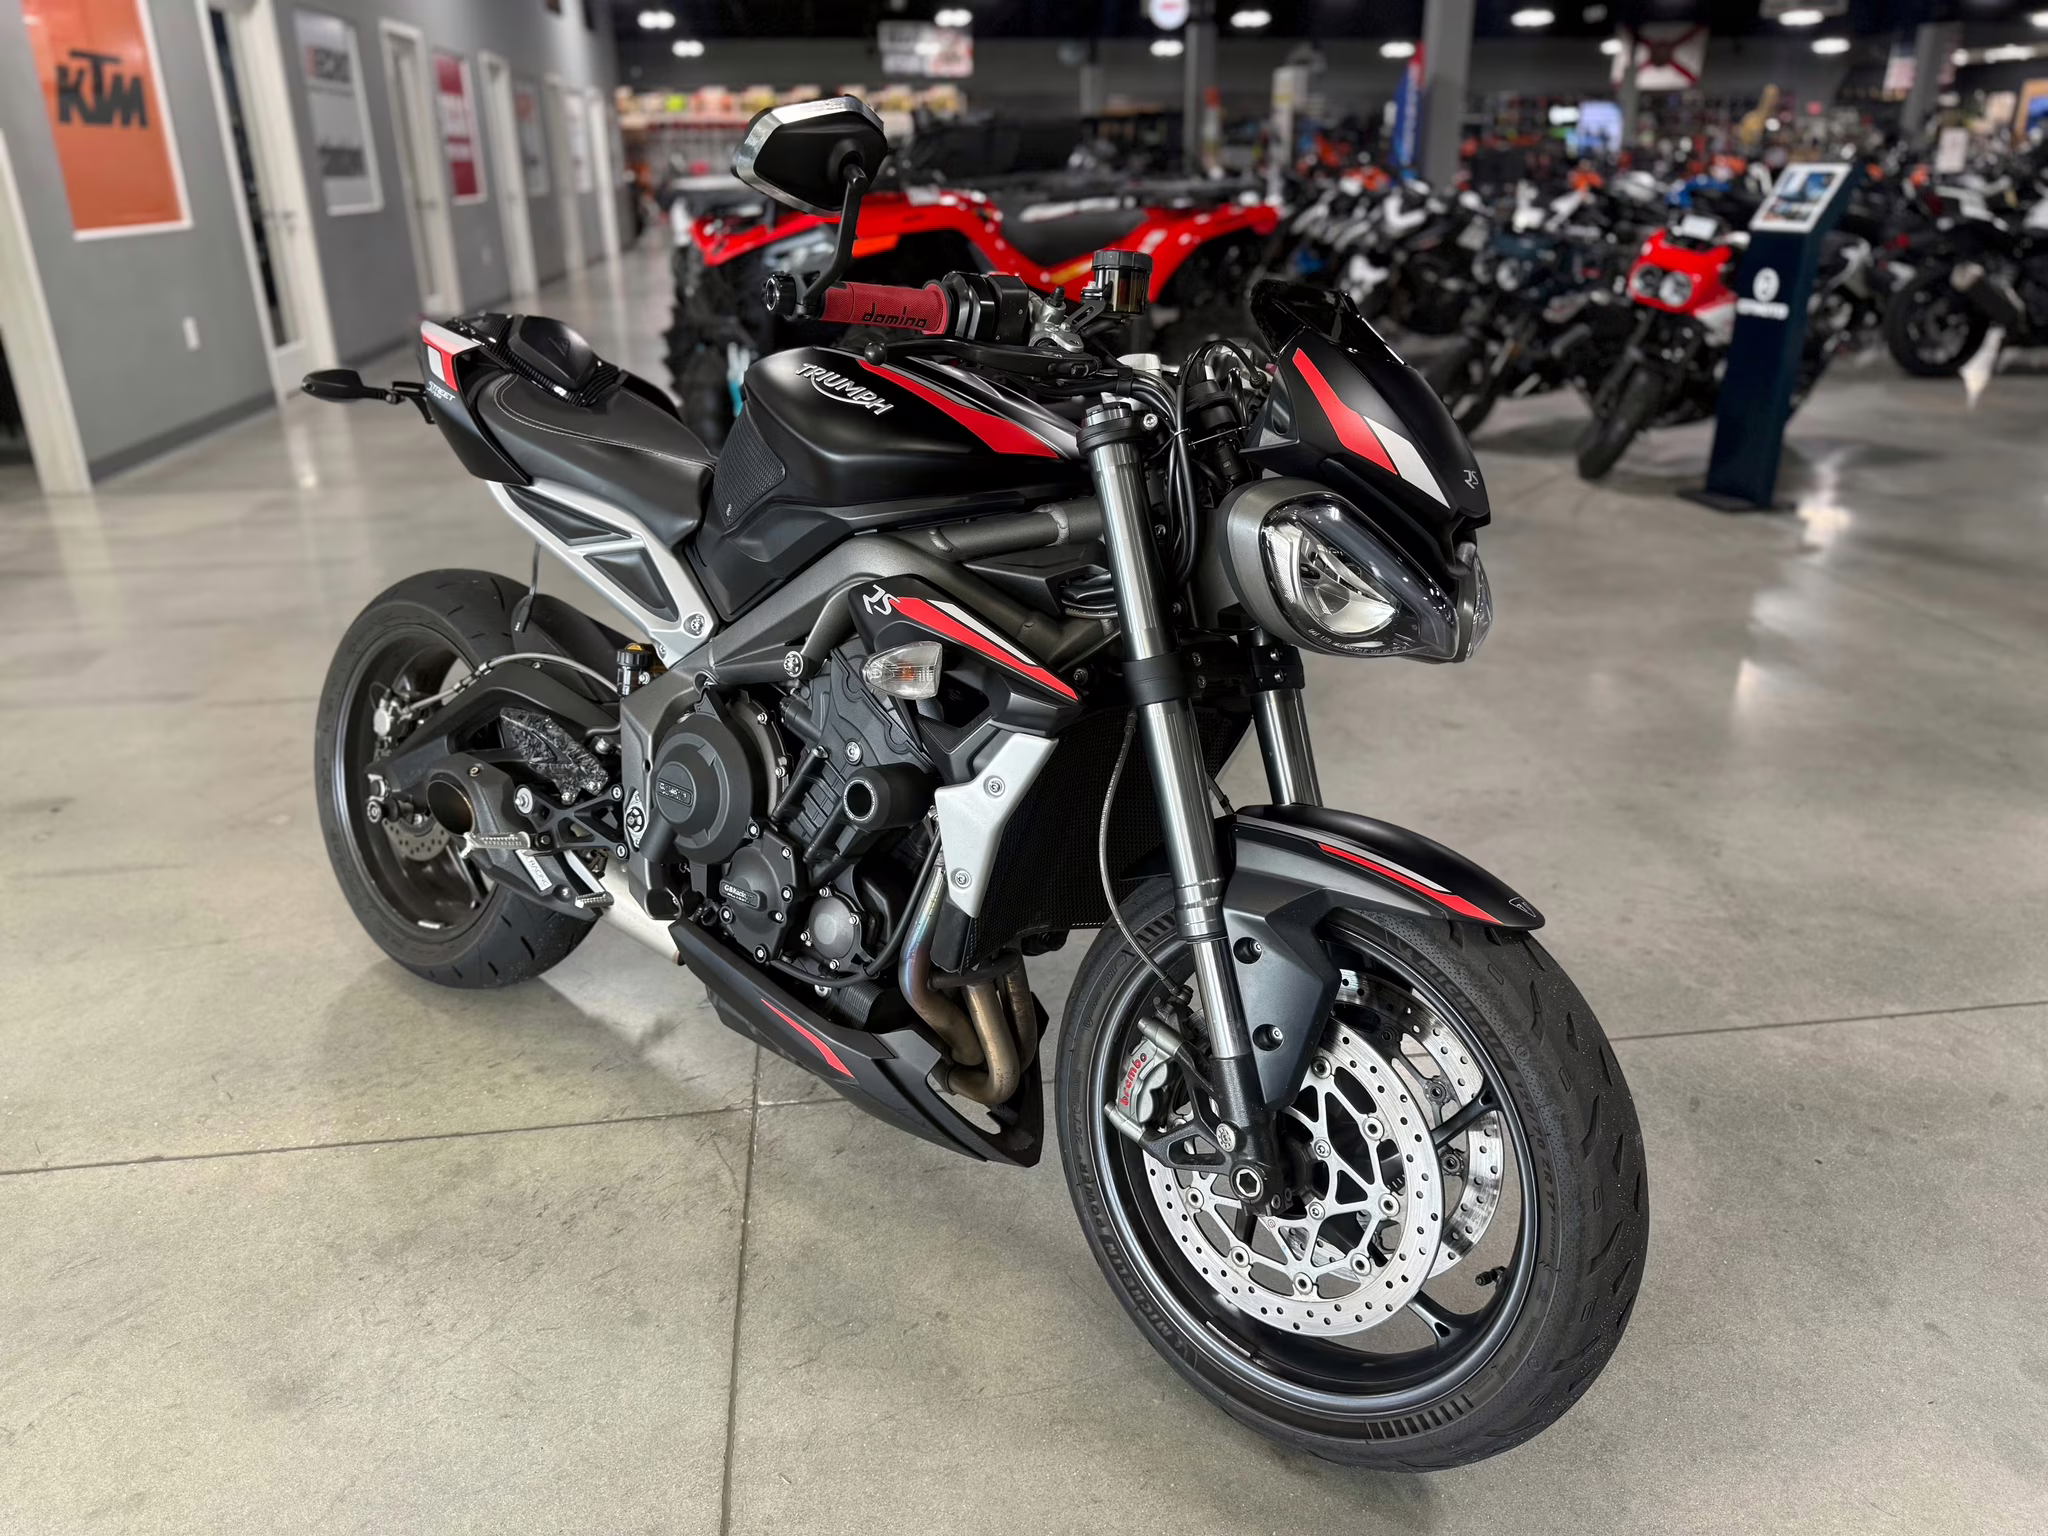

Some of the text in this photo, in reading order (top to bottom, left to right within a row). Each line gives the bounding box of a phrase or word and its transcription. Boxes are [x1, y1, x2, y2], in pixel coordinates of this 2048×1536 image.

[57, 48, 147, 128] KTM
[861, 302, 928, 329] domino
[428, 380, 456, 402] STREET
[795, 362, 894, 416] TRIUMPH
[1463, 469, 1479, 490] RS
[862, 583, 901, 616] RS
[1417, 958, 1511, 1066] MICHELIN
[1120, 1052, 1148, 1107] brembo
[1514, 1080, 1546, 1151] 120/70
[1104, 1242, 1173, 1337] MICHELIN
